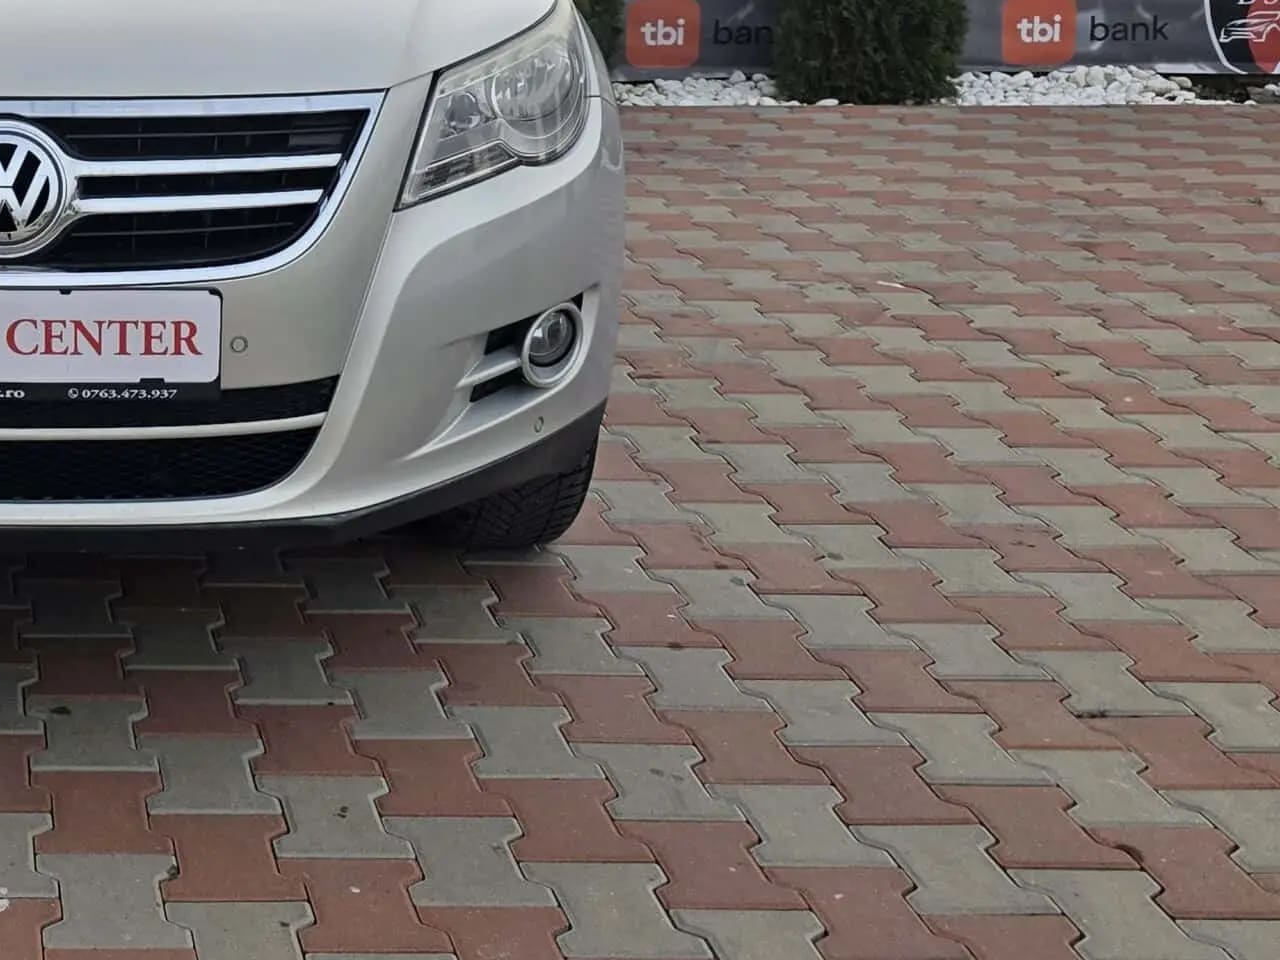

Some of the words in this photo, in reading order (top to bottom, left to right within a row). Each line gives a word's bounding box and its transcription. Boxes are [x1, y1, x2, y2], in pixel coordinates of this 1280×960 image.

[640, 18, 686, 46] tbi
[713, 19, 776, 46] ban
[1016, 14, 1062, 43] tbi
[1089, 15, 1169, 42] bank
[5, 318, 203, 356] CENTER
[81, 388, 178, 399] 0763.473.937
